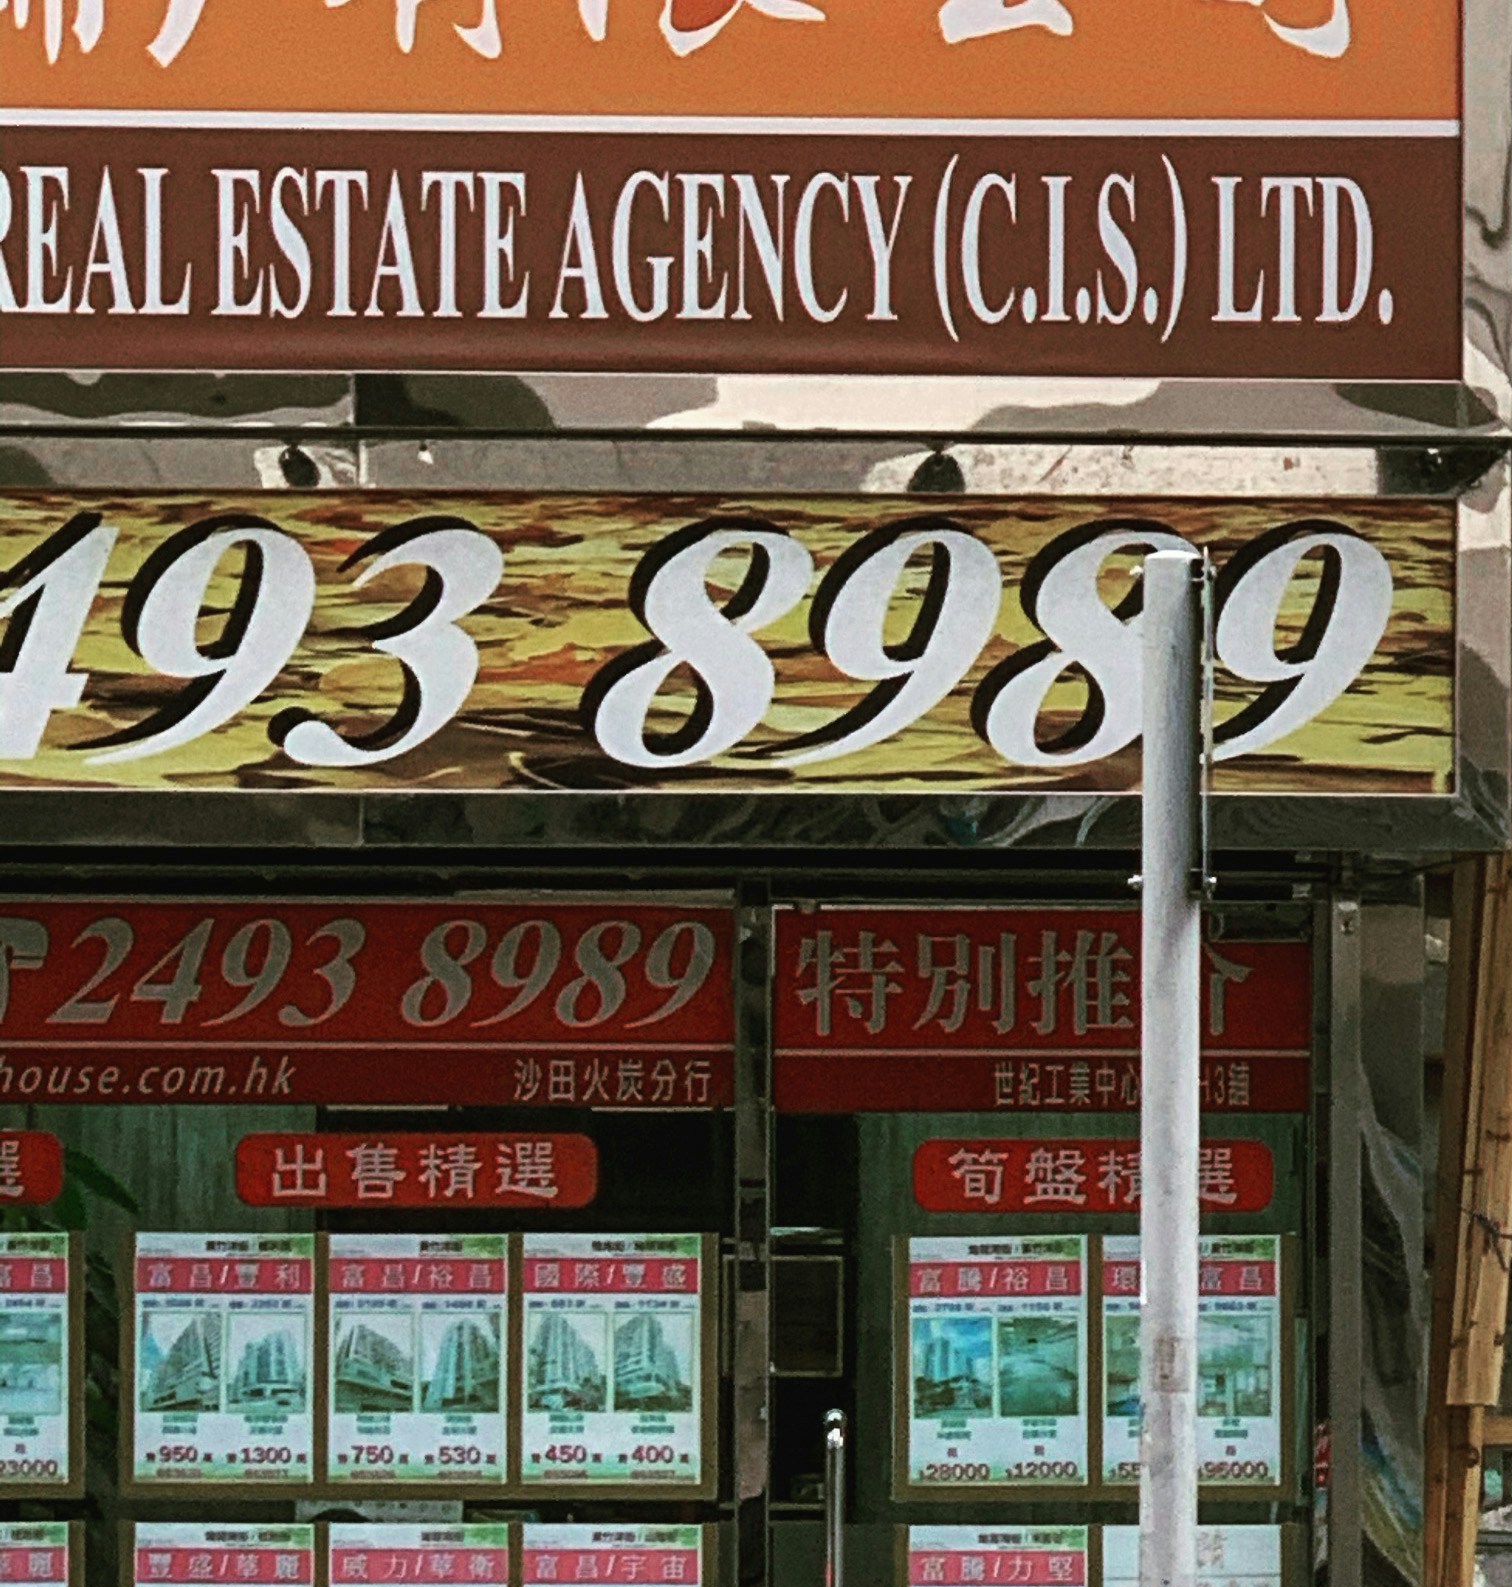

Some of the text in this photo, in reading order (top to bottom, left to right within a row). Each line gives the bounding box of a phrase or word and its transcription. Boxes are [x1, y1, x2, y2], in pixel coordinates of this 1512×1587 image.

[0, 153, 1394, 343] EAL ESTATE AGENCY (C.I.S.) LTD.
[585, 515, 1394, 768] 8989
[46, 917, 715, 1029] 2493 8989
[514, 1058, 712, 1102] 沙田火炭分行
[272, 1141, 559, 1199] 出售精選
[240, 1446, 292, 1465] 1300
[350, 1446, 394, 1465] 750
